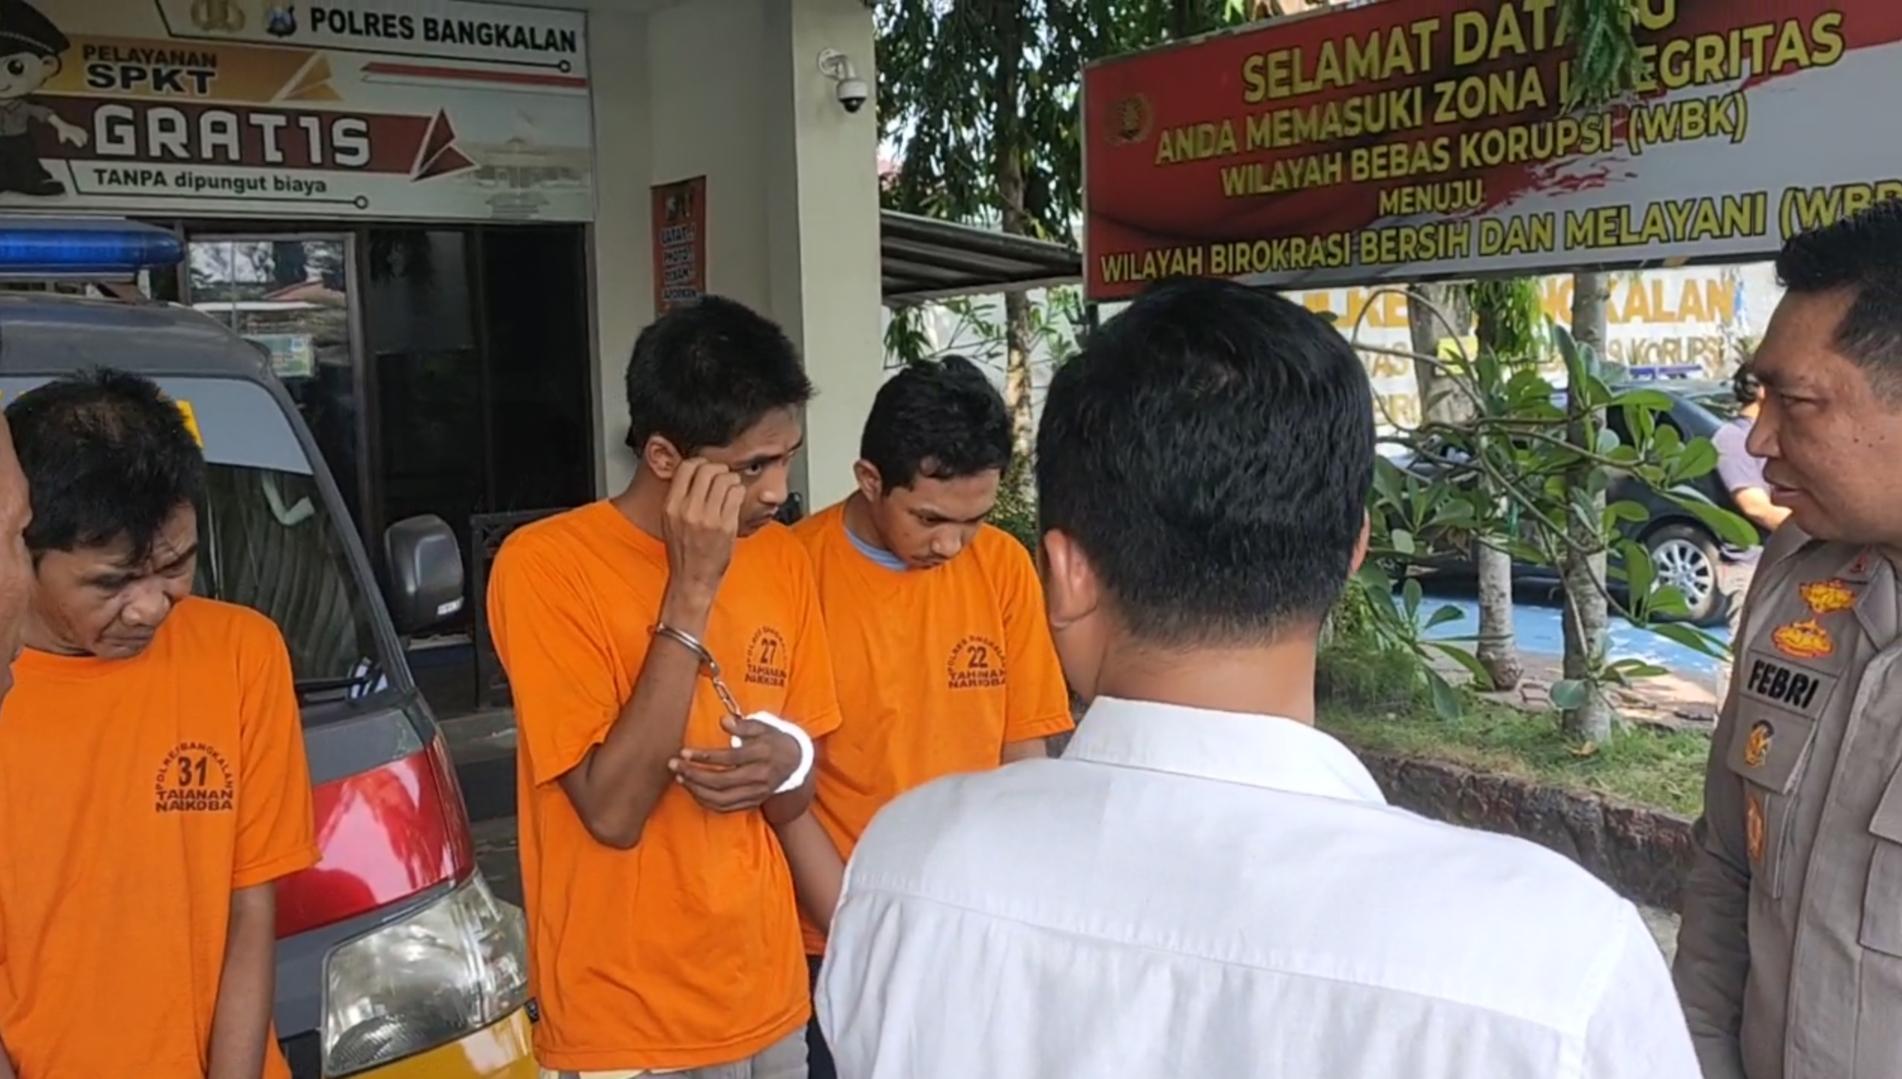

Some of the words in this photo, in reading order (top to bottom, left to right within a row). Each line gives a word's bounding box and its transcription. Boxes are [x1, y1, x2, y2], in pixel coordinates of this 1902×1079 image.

[311, 7, 414, 40] POLRES
[423, 17, 577, 52] BANGKALAN
[83, 44, 217, 68] PELAYANAN
[1243, 18, 1440, 103] SELAMAT
[87, 63, 216, 95] SPKT
[1155, 119, 1238, 165] ANDA
[1246, 86, 1423, 151] MEMASUKI
[1433, 66, 1547, 124] ZONA
[1221, 152, 1343, 197] WILAYAH
[1351, 136, 1450, 183] BEBAS
[1459, 112, 1613, 170] KORUPSI
[1628, 90, 1749, 156] (WBK)
[94, 168, 167, 188] TANPA
[174, 172, 268, 194] dipungut
[272, 175, 328, 196] biaya
[1378, 178, 1484, 217] MENUJU
[1100, 246, 1203, 283] WILAYAH
[1210, 231, 1352, 276] BIROKRASI
[1359, 219, 1471, 264] BERSIH
[1479, 212, 1555, 257] DAN
[1563, 190, 1769, 251] MELAYANI
[760, 637, 778, 665] 27
[966, 645, 989, 669] 22
[1747, 658, 1820, 709] FEBRI
[178, 755, 208, 787] 31
